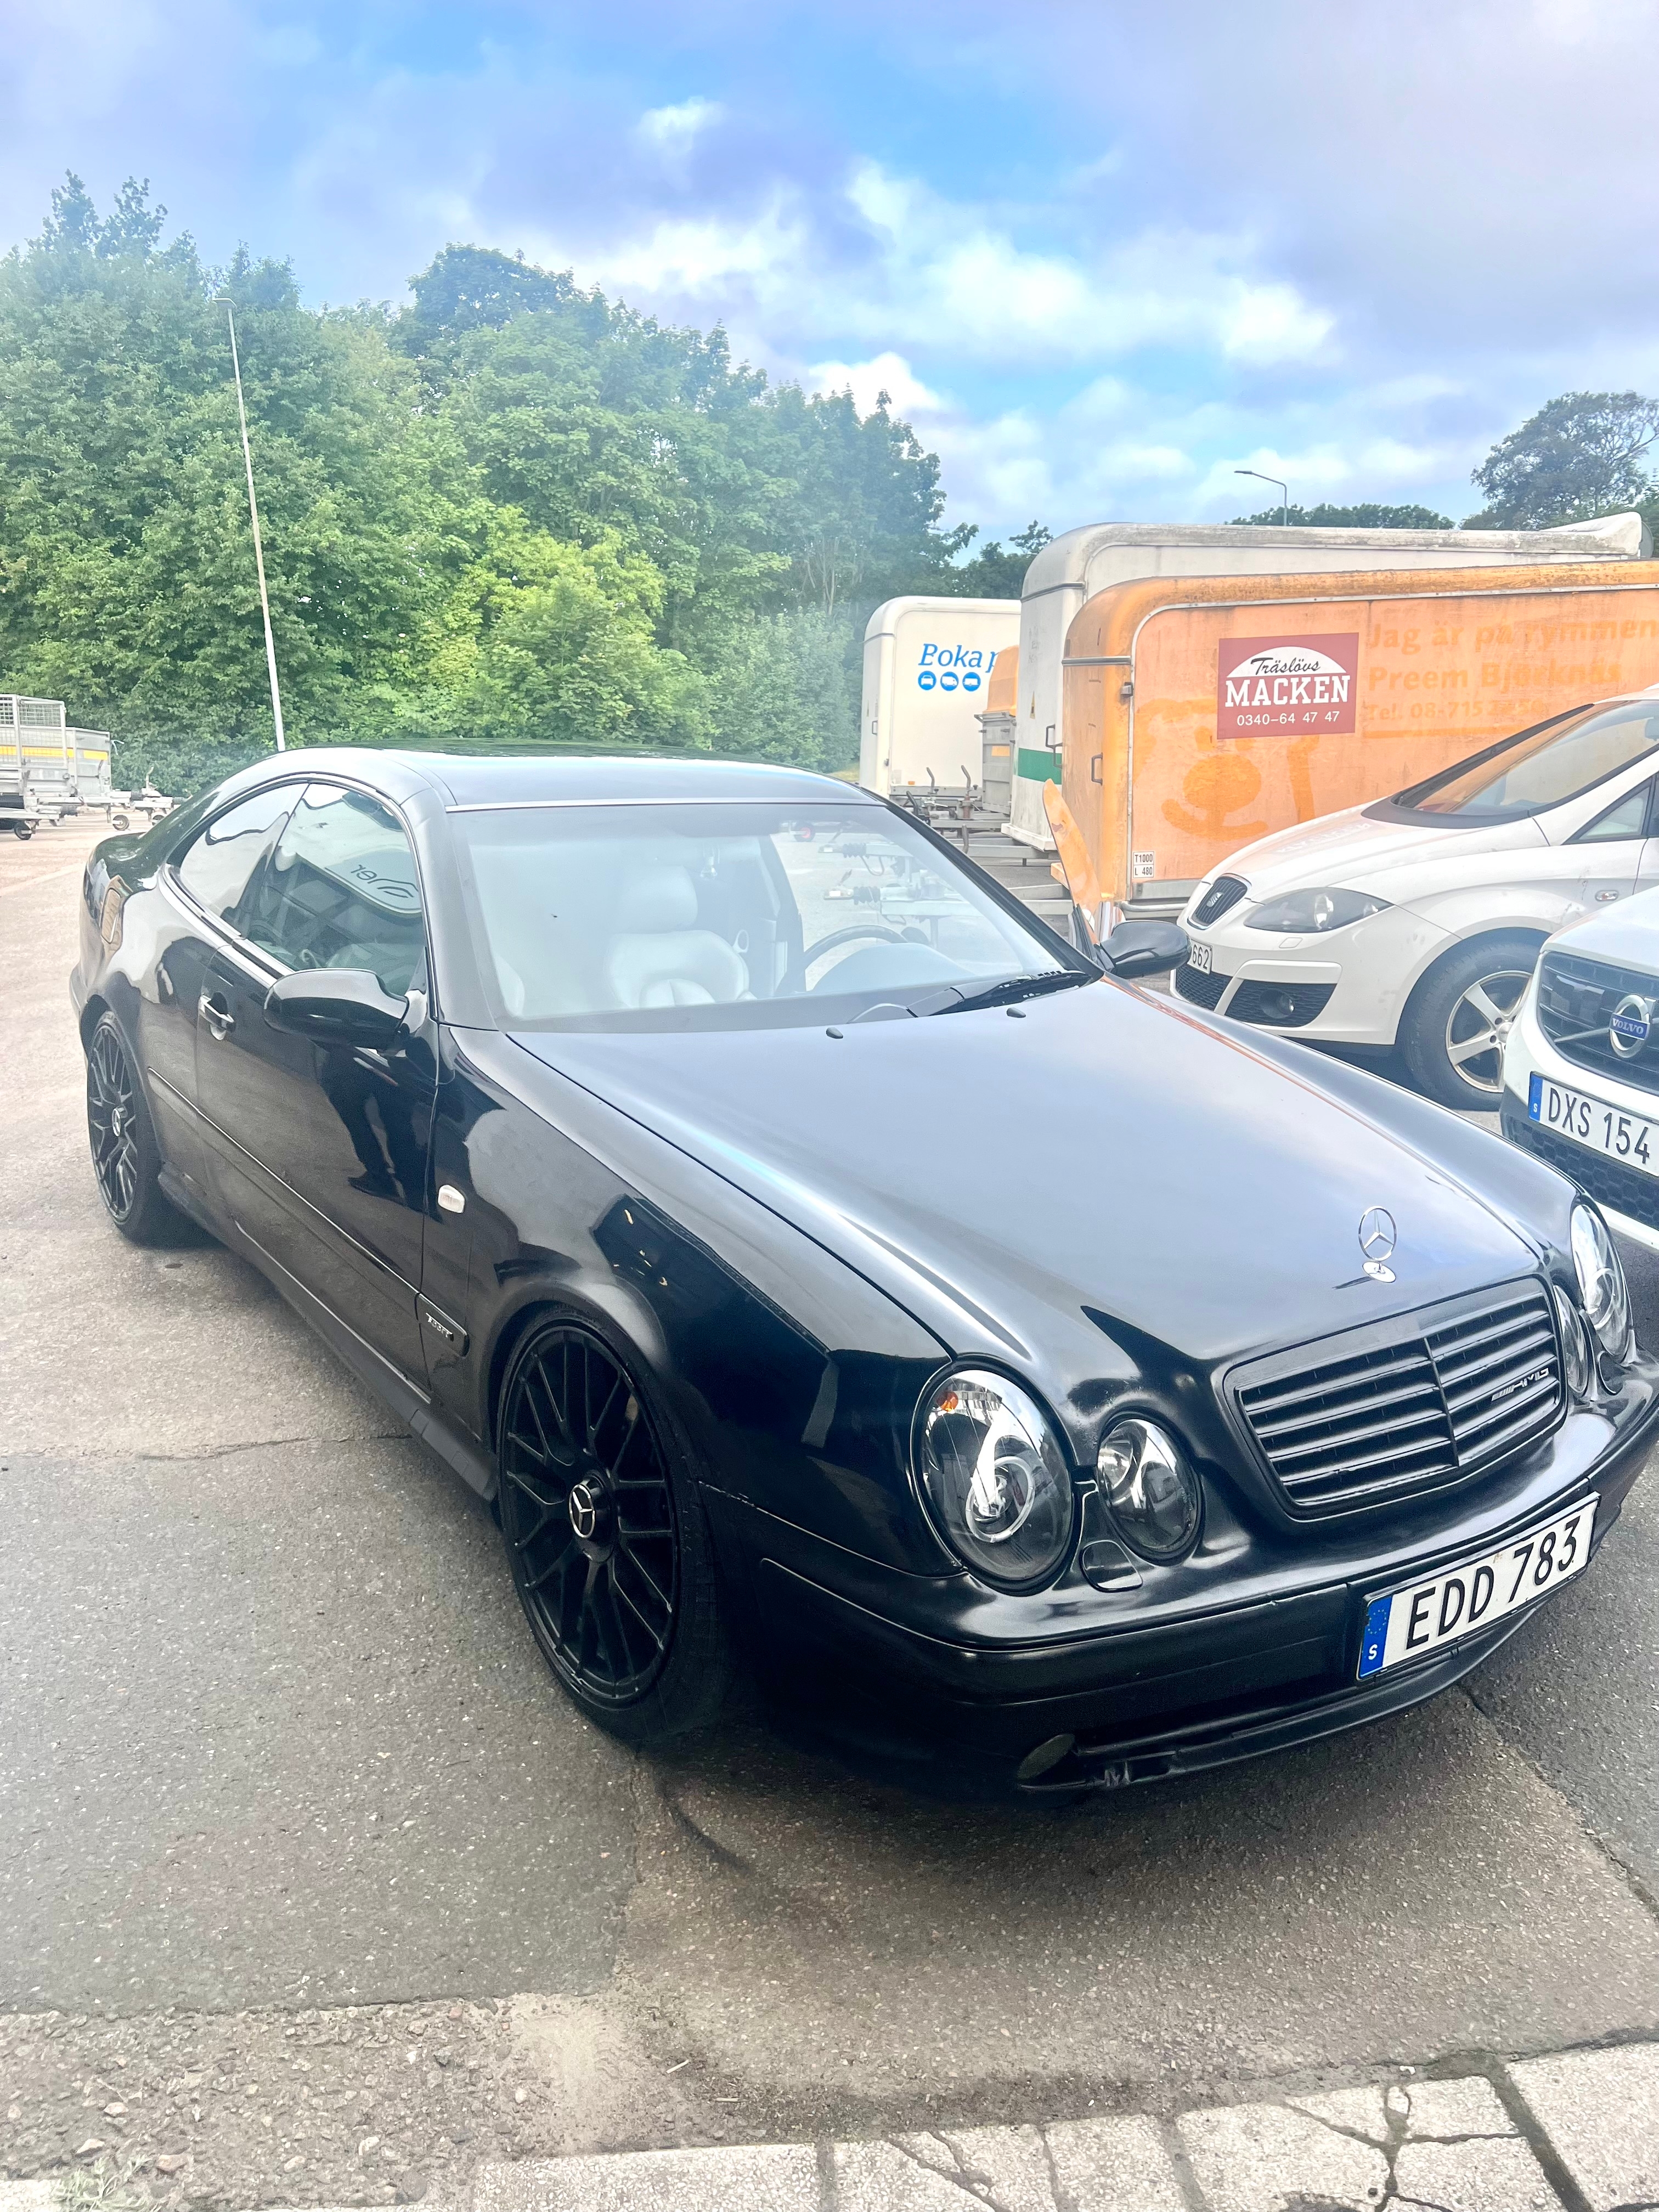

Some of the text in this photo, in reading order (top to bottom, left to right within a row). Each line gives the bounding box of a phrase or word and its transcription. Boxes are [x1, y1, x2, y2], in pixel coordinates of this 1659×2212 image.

[1369, 623, 1421, 655] Jag
[1431, 620, 1464, 646] är
[1526, 619, 1658, 651] rymmen
[918, 643, 983, 668] Boka
[1250, 657, 1321, 675] Träslövs
[1368, 656, 1622, 694] Preem Björknäs
[1224, 675, 1351, 708] MACKEN
[1237, 710, 1340, 726] 0340-64 47 47
[1365, 703, 1403, 721] Tel.
[1135, 854, 1153, 863] T1000
[1135, 866, 1153, 876] L 480
[1192, 944, 1210, 970] 662
[1612, 1017, 1644, 1035] VOLVO
[1533, 1102, 1538, 1113] S
[1548, 1087, 1650, 1164] DXS 154
[1406, 1515, 1581, 1650] EDD 783
[1368, 1644, 1378, 1661] S
